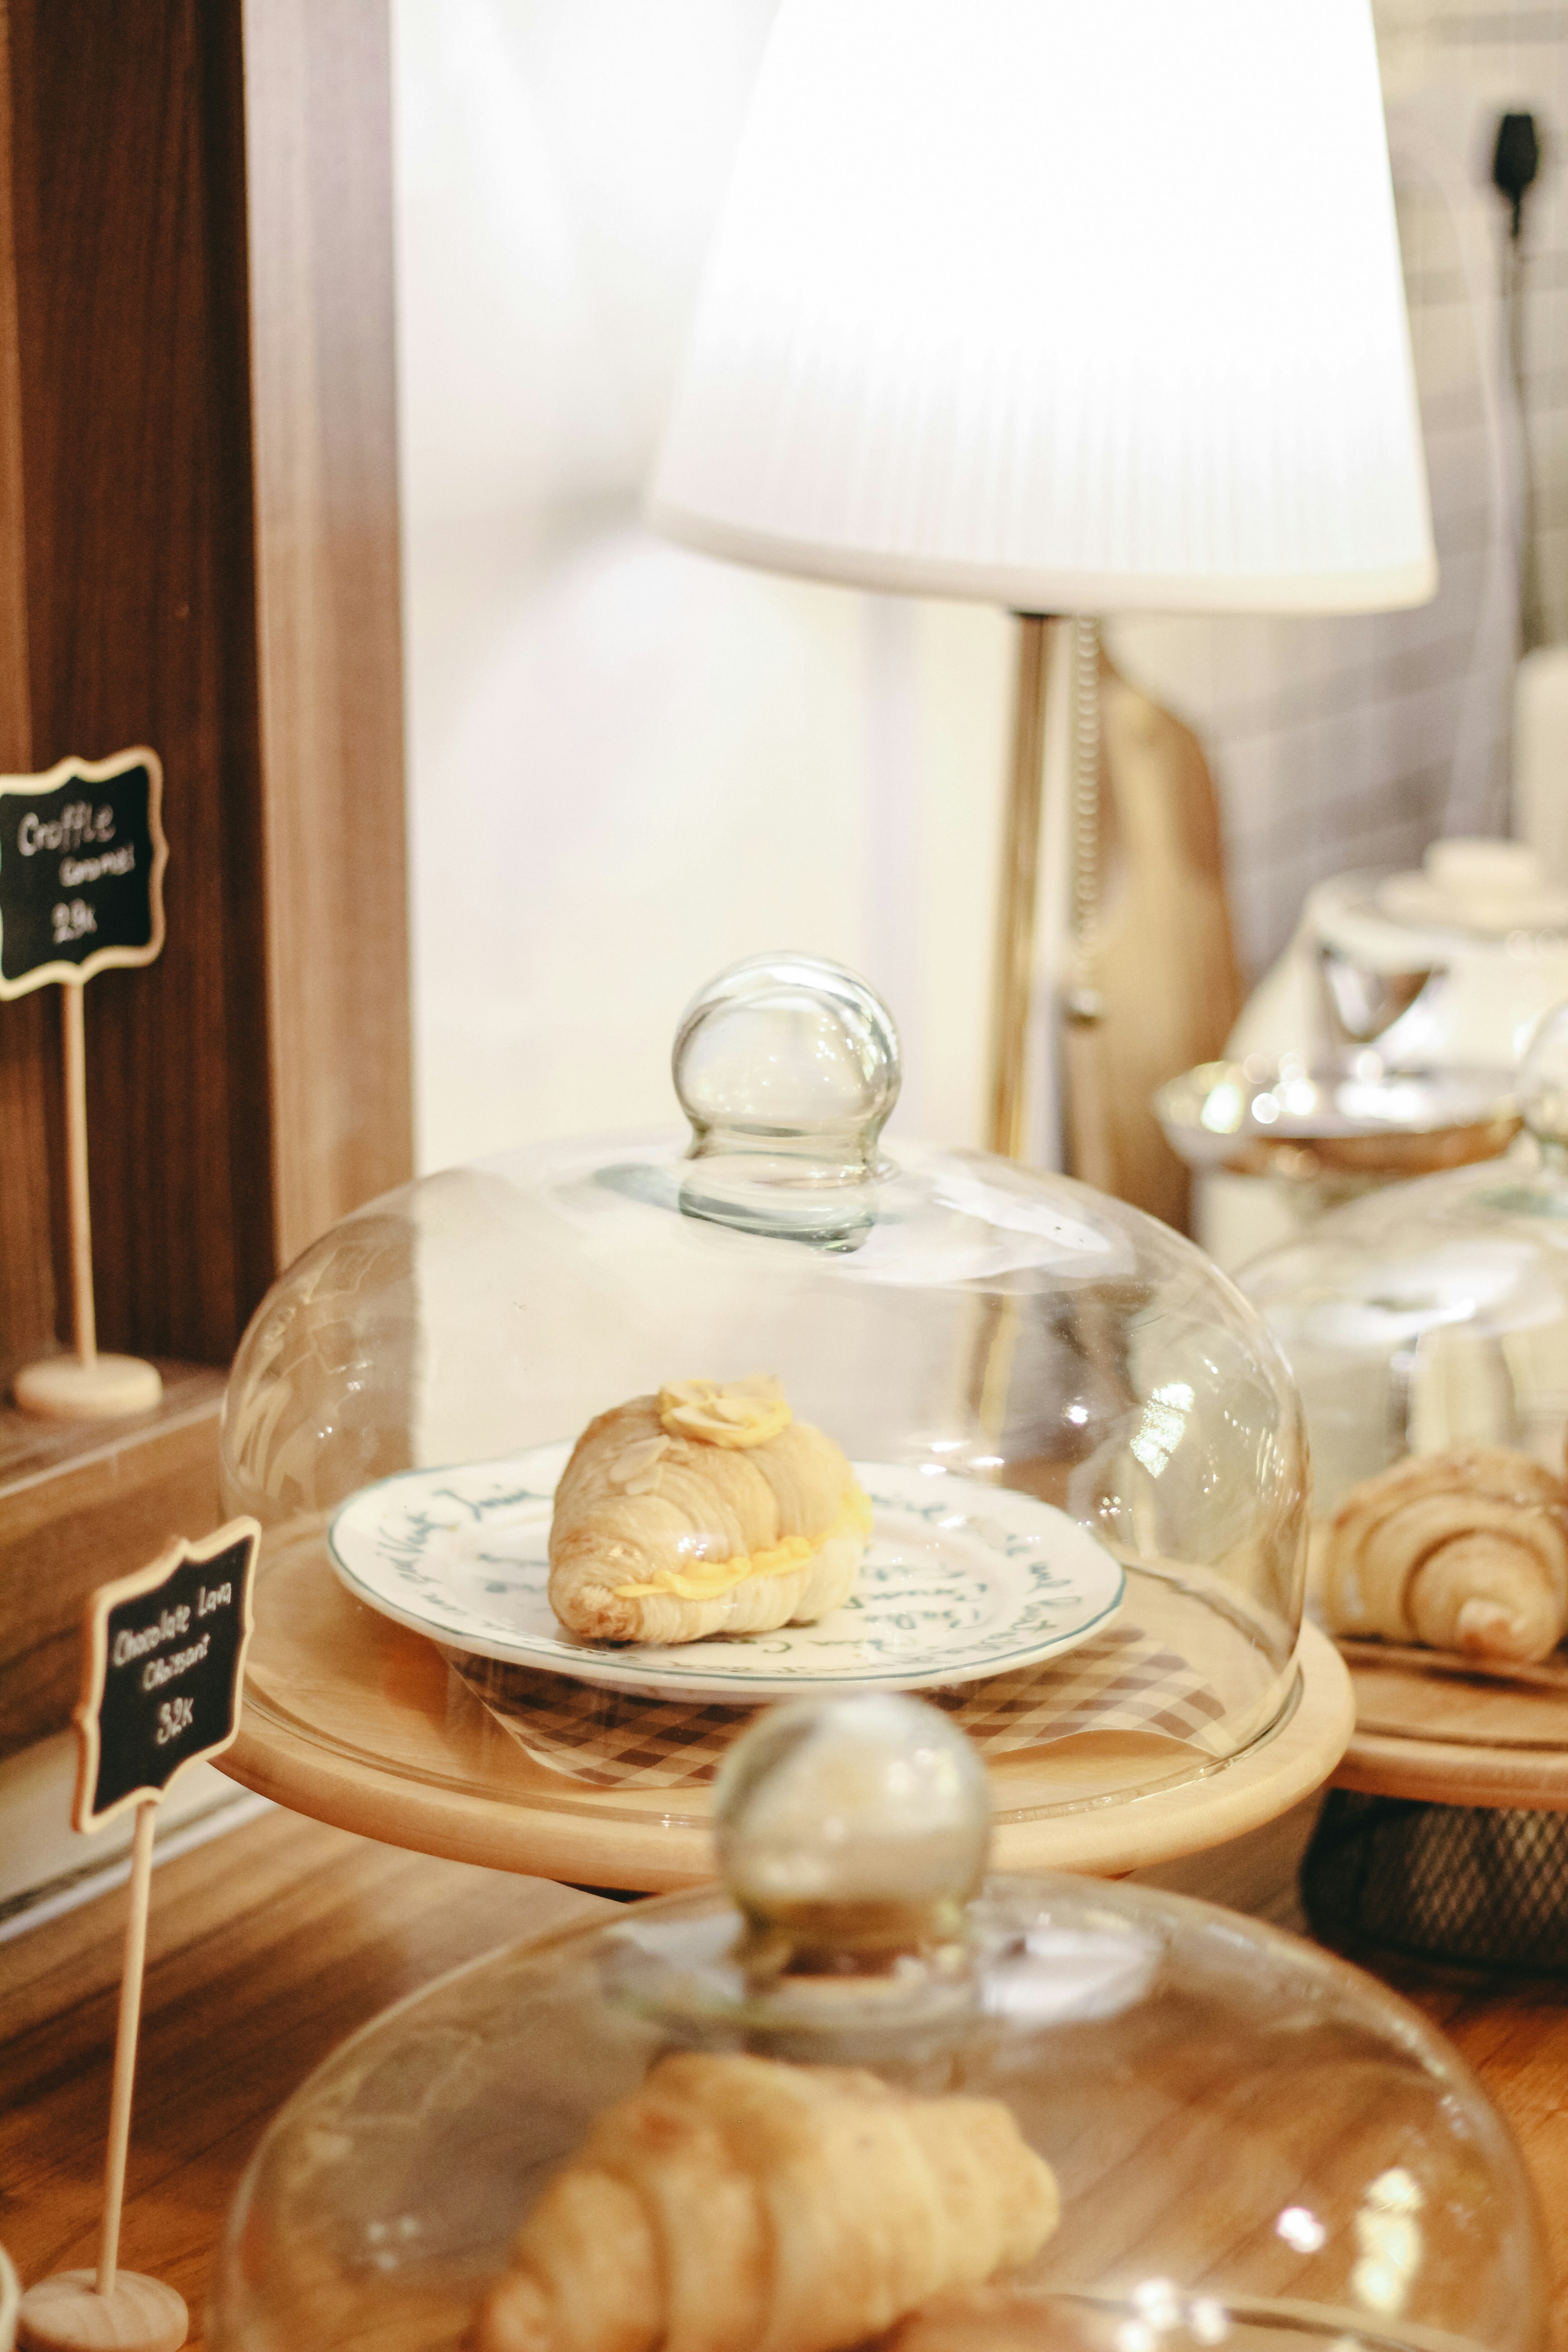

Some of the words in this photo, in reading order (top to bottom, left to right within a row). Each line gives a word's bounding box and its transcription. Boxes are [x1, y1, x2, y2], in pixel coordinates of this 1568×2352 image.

[18, 802, 114, 857] Croffle
[111, 1604, 191, 1667] Chocolate
[196, 1582, 232, 1618] Lava
[142, 1632, 211, 1692] Croissant
